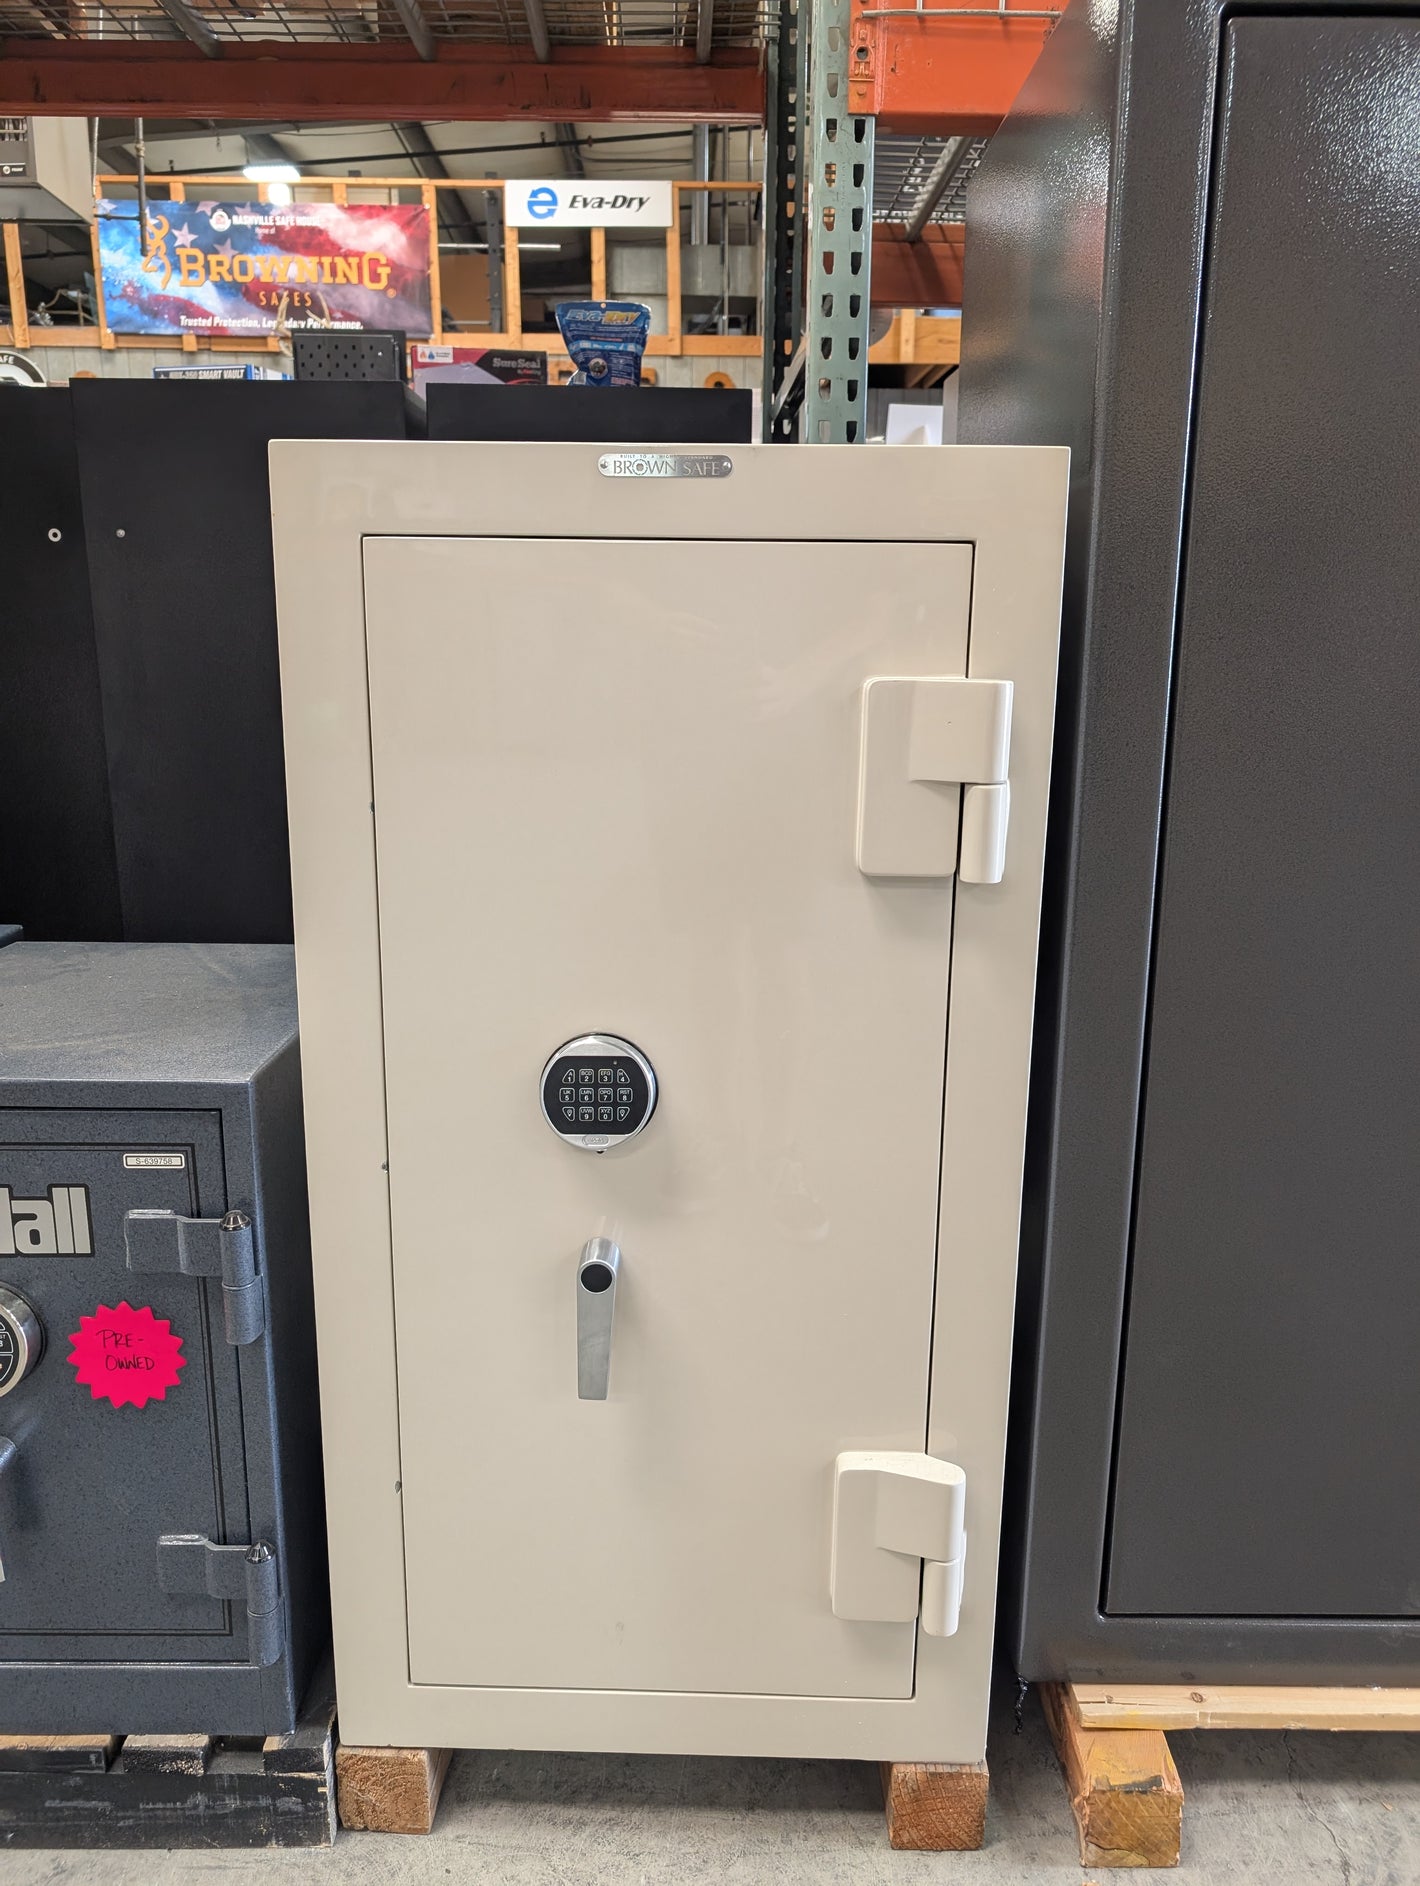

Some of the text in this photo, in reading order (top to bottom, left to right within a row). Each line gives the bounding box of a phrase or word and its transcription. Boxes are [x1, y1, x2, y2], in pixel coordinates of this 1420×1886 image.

[568, 194, 651, 212] Eva-Dry
[232, 214, 274, 225] NASHVILLE
[275, 215, 296, 226] SAFE
[176, 247, 391, 290] BROWNING
[258, 290, 313, 307] SAES
[180, 315, 211, 327] Trusted
[212, 316, 260, 329] Protection,
[198, 370, 222, 379] SMART
[223, 369, 246, 379] VAULT
[613, 459, 720, 476] BROWN SAFE
[135, 1157, 173, 1165] S-639758
[105, 1354, 155, 1371] OWNED
